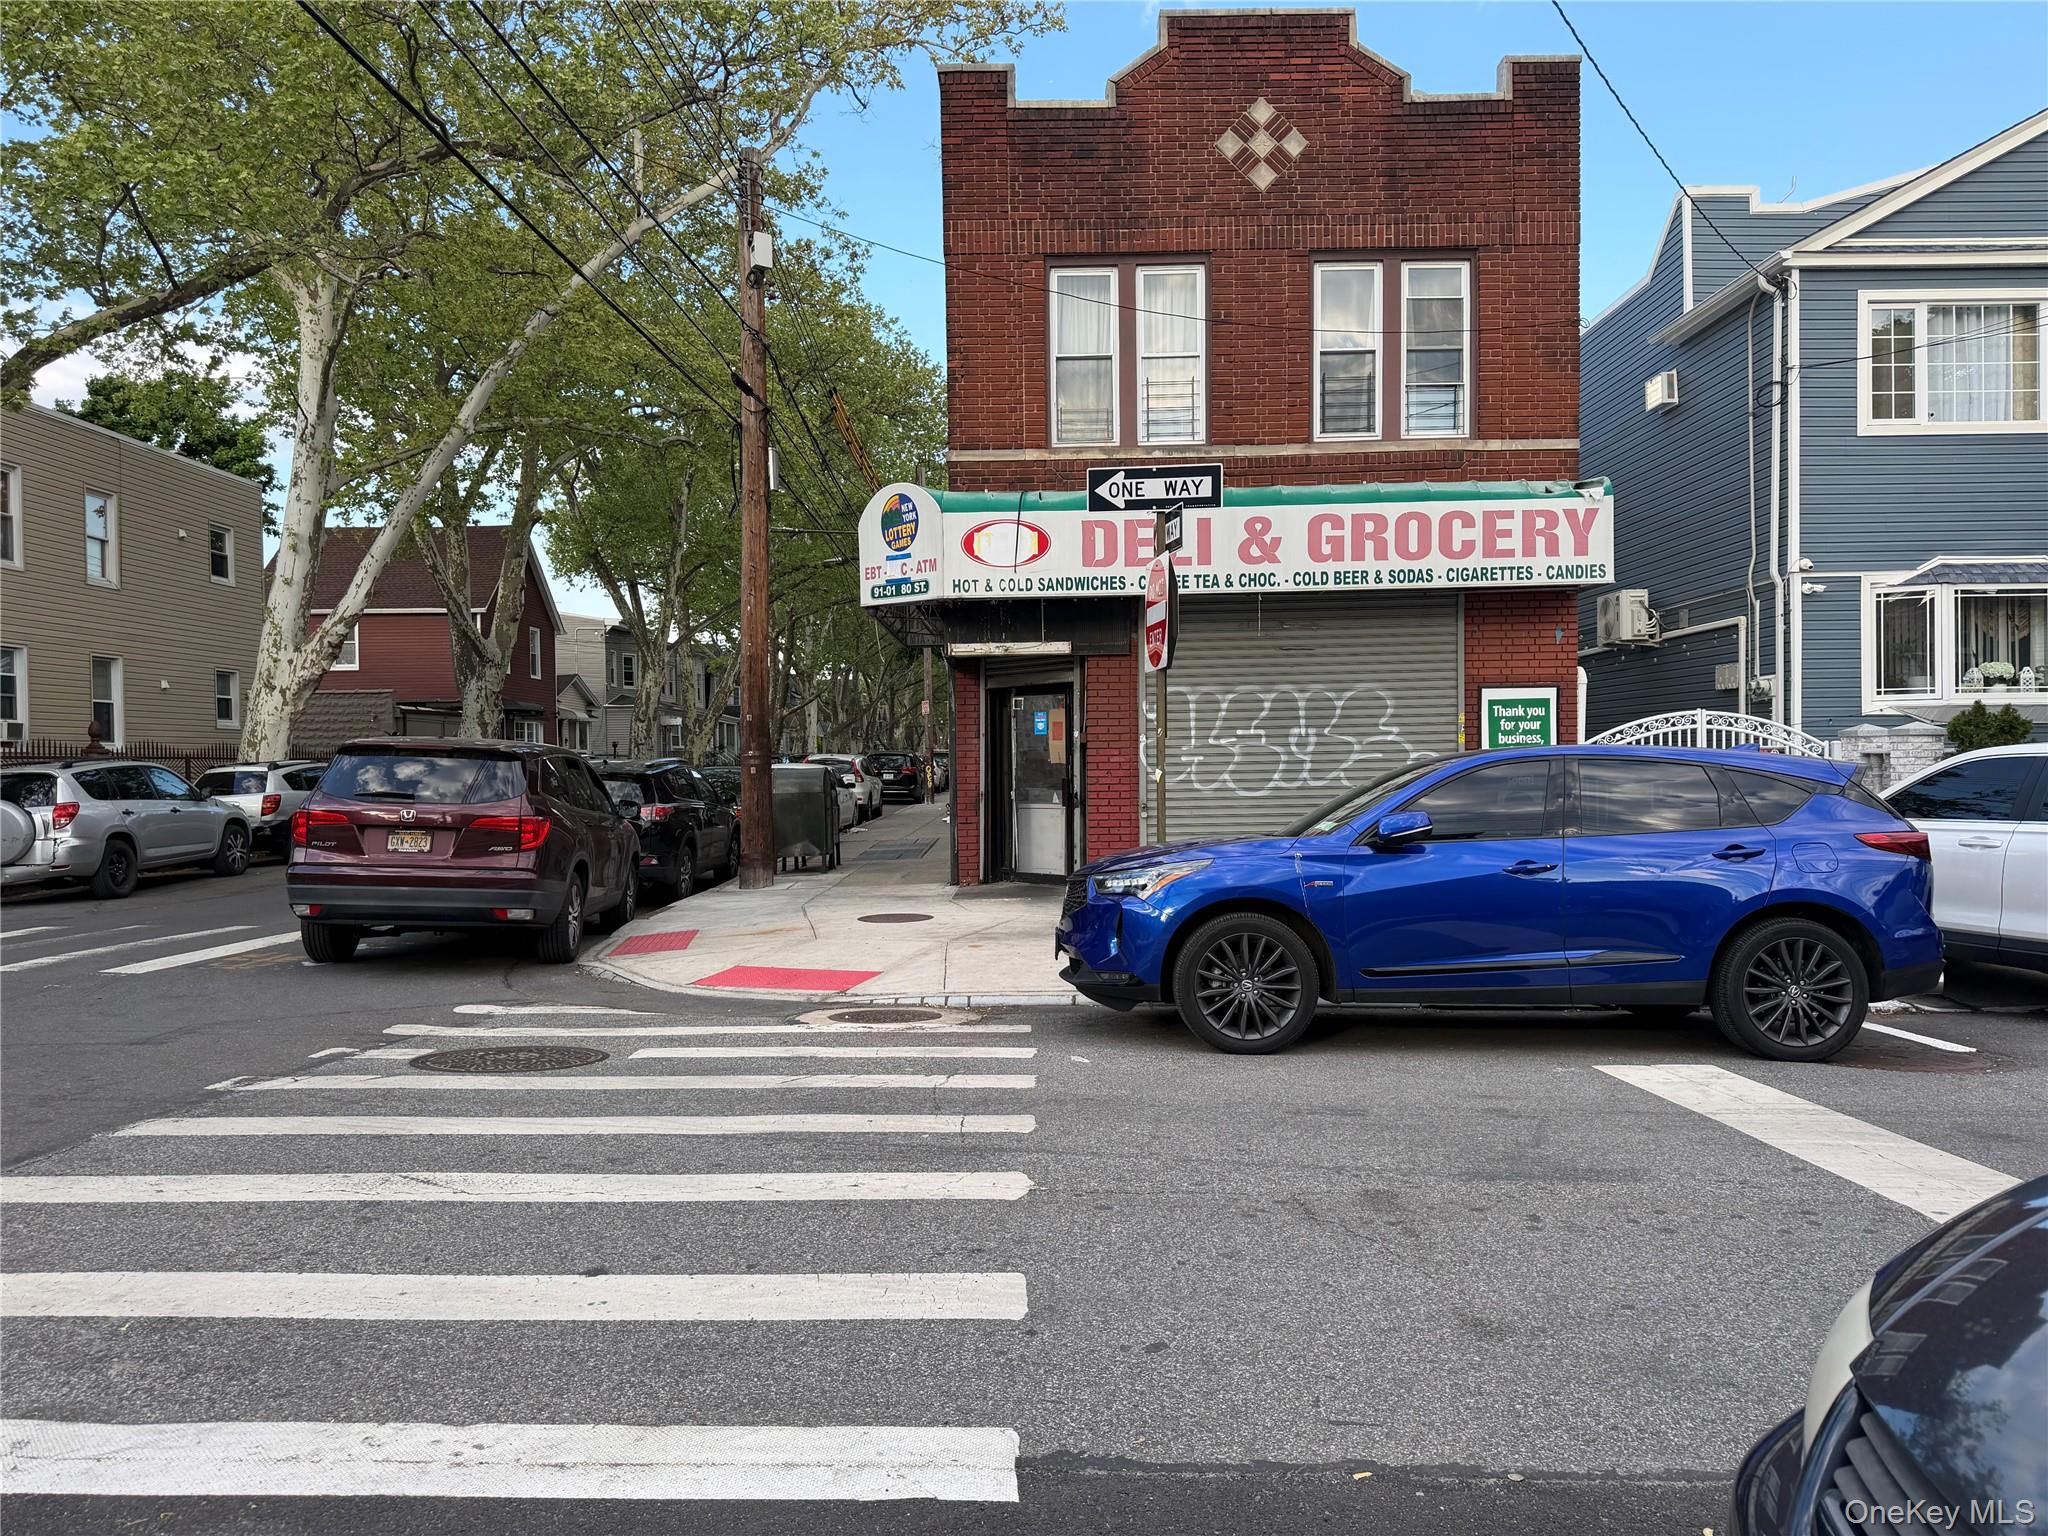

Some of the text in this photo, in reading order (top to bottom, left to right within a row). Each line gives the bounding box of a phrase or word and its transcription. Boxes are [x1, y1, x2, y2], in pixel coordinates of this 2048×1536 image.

[1109, 479, 1204, 498] ONE WAY
[901, 501, 913, 512] NEW
[902, 511, 917, 522] YORK
[885, 522, 916, 541] LOTTERY
[1081, 507, 1600, 567] DEI & GROCERY
[891, 537, 912, 549] GAMES
[865, 565, 882, 580] EBT
[916, 558, 937, 574] ATM
[952, 579, 979, 593] HOT
[985, 579, 993, 592] &
[999, 577, 1033, 592] COLD
[1038, 575, 1126, 591] SANDWICHES
[1193, 574, 1220, 588] TEA
[1224, 573, 1234, 587] &
[1238, 572, 1280, 588] CHOC.
[1293, 571, 1328, 587] COLD
[1333, 570, 1369, 585] BEER
[1374, 569, 1383, 584] &
[1388, 567, 1433, 584] SODAS
[1446, 565, 1533, 583] CIGARETTES
[1546, 563, 1606, 580] CANDIES
[874, 581, 927, 597] 91-01 80 ST.
[1493, 705, 1545, 719] Thank you
[1500, 719, 1541, 733] for your
